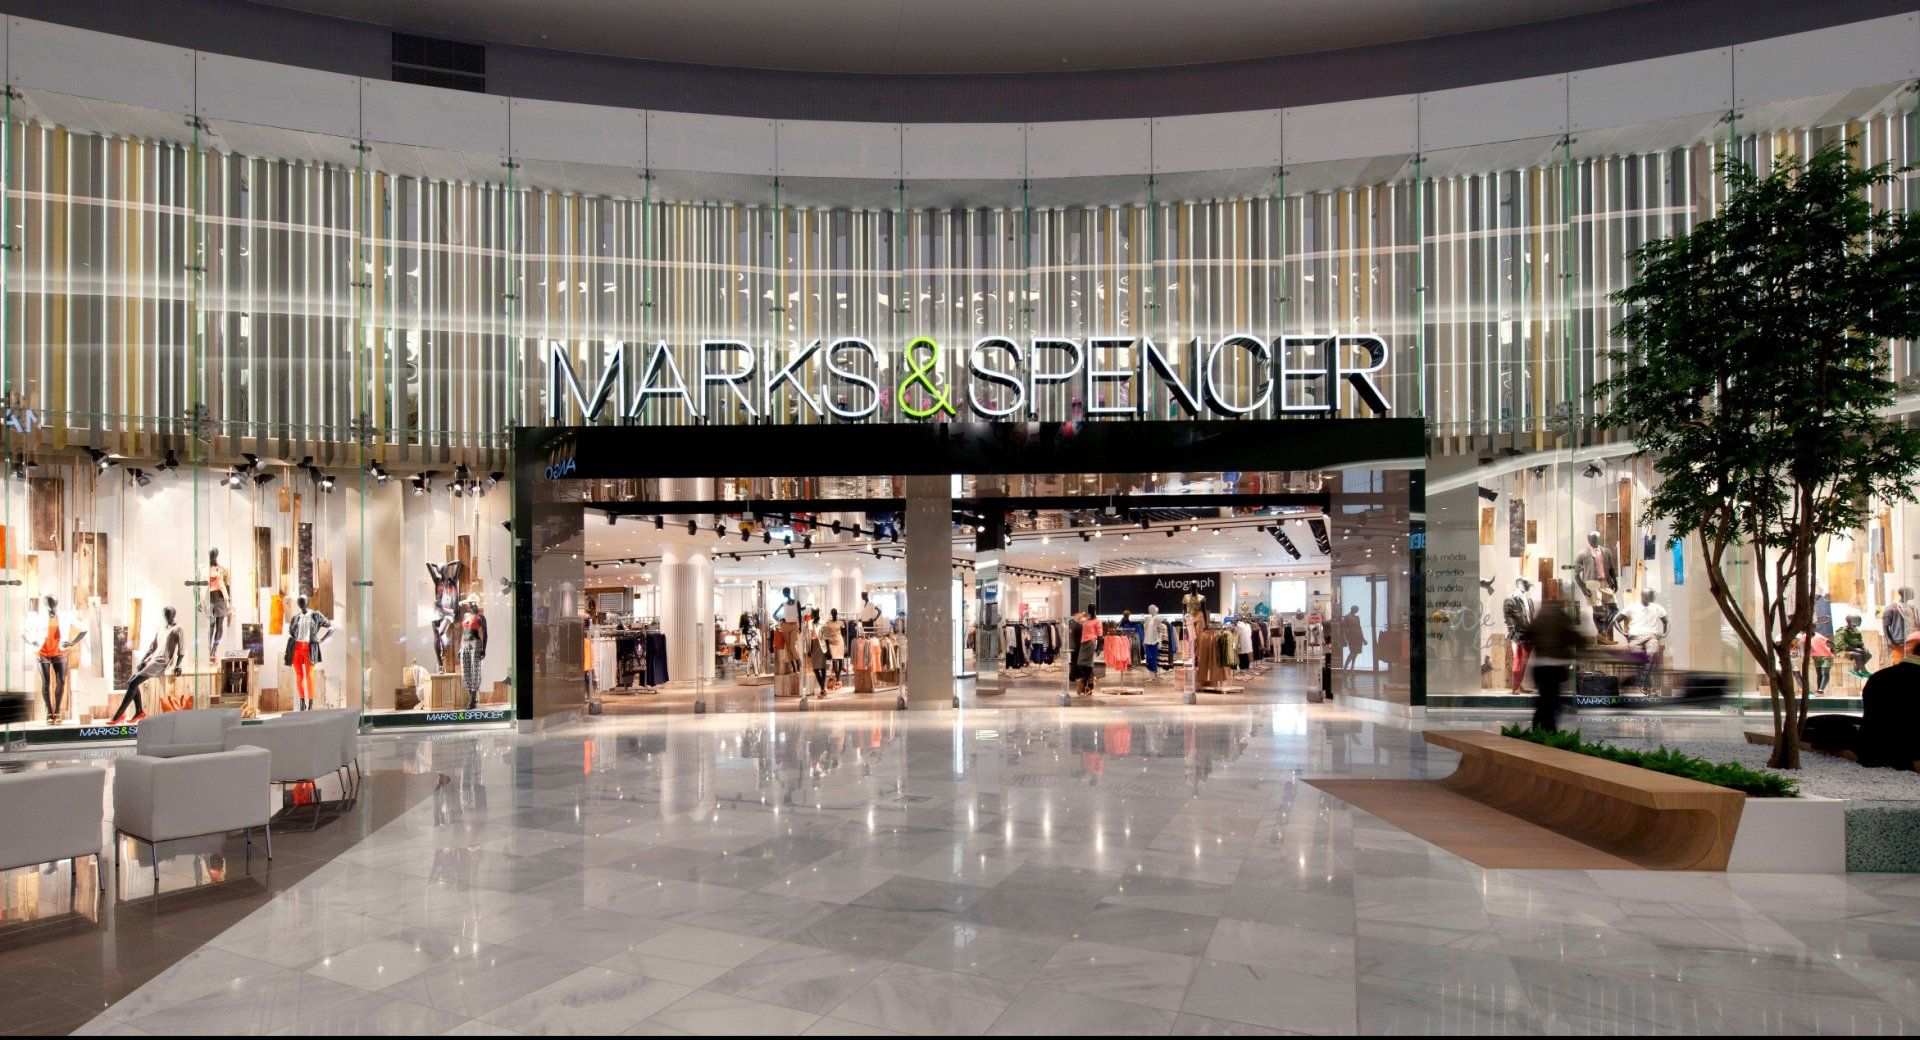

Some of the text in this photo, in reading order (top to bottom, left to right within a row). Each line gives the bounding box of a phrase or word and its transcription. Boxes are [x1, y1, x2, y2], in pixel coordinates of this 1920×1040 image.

[549, 333, 1392, 421] MARKS & SPENCER
[1440, 552, 1467, 561] móda
[1436, 568, 1465, 578] prádlo
[1437, 583, 1464, 592] móda
[1576, 697, 1611, 705] MARKS
[426, 712, 458, 721] MARKS
[465, 710, 504, 720] SPENCER
[80, 727, 120, 736] MARKS
